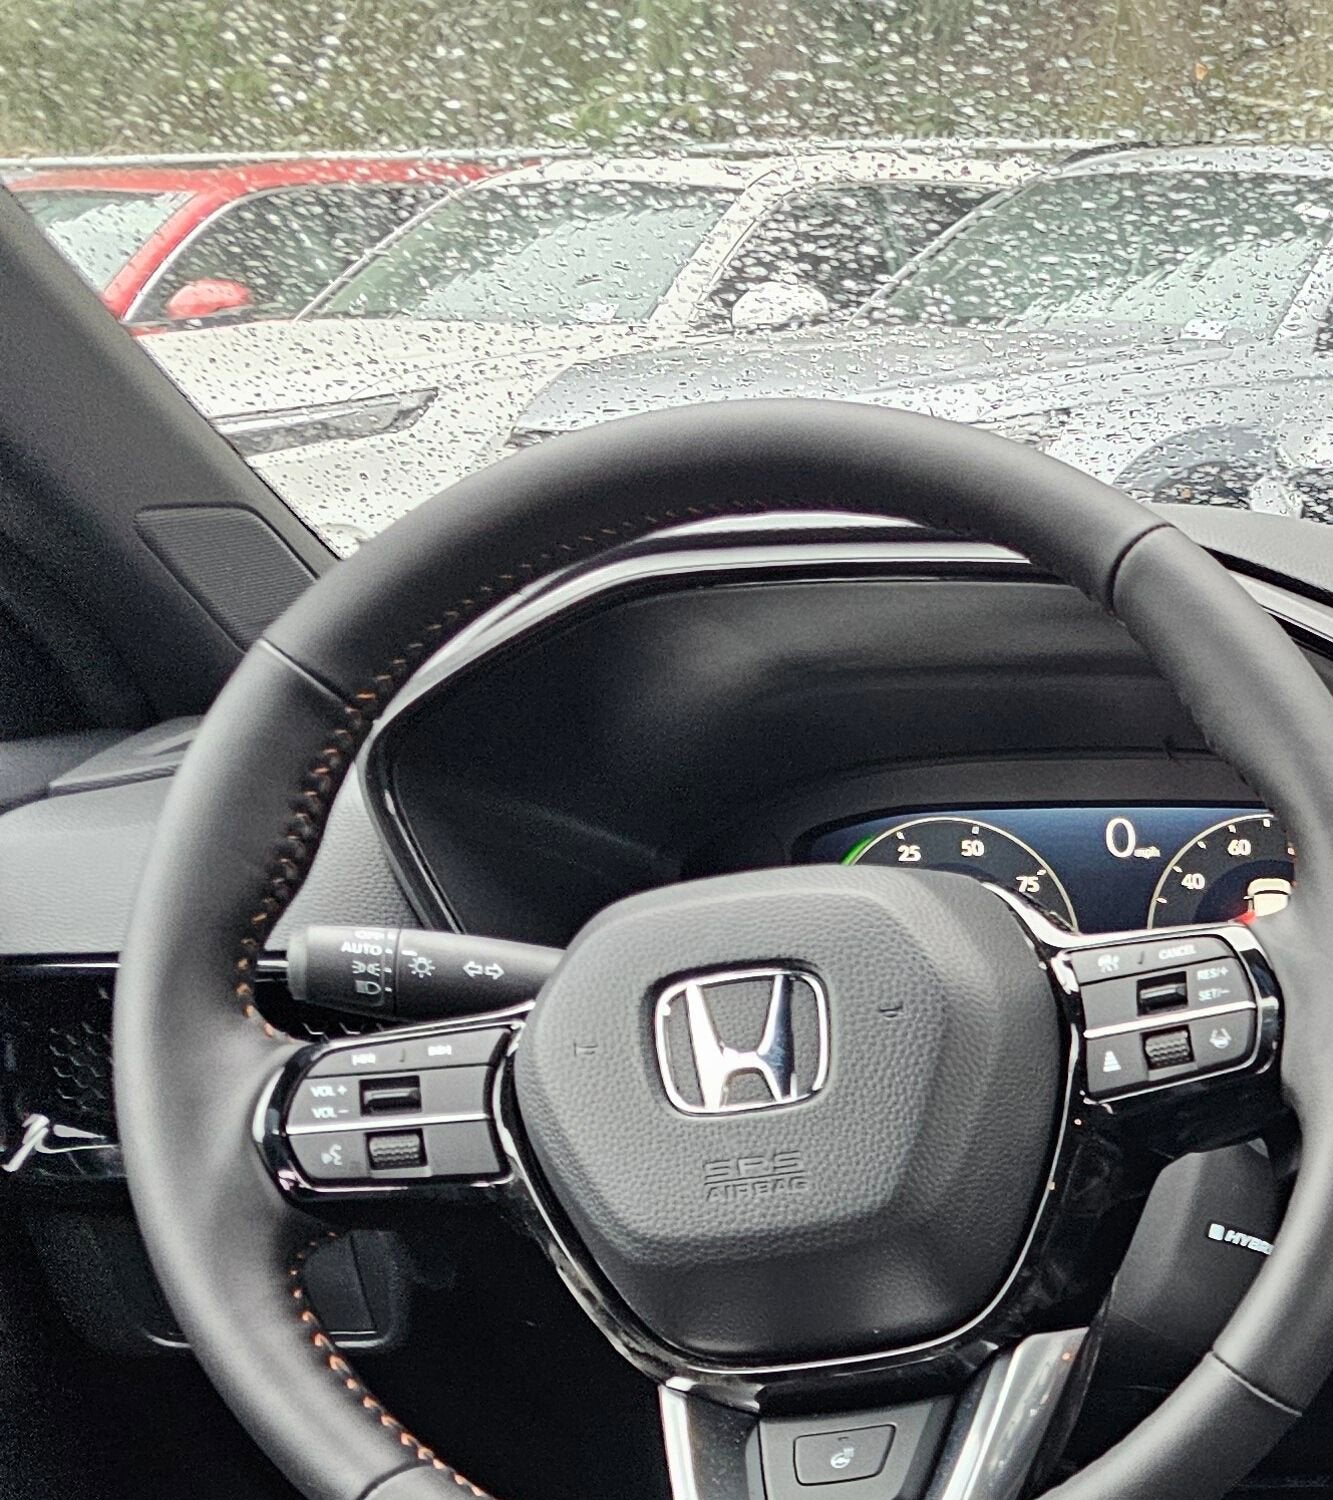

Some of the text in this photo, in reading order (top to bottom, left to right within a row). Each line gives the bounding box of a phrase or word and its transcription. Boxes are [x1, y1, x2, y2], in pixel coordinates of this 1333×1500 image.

[1106, 817, 1136, 858] 0
[897, 844, 921, 862] 25
[961, 840, 985, 858] 50
[1227, 839, 1252, 857] 60
[1015, 876, 1040, 895] 75
[1181, 872, 1206, 891] 40
[341, 941, 383, 956] AUTO
[310, 1085, 337, 1098] VOL
[311, 1106, 337, 1119] VOL
